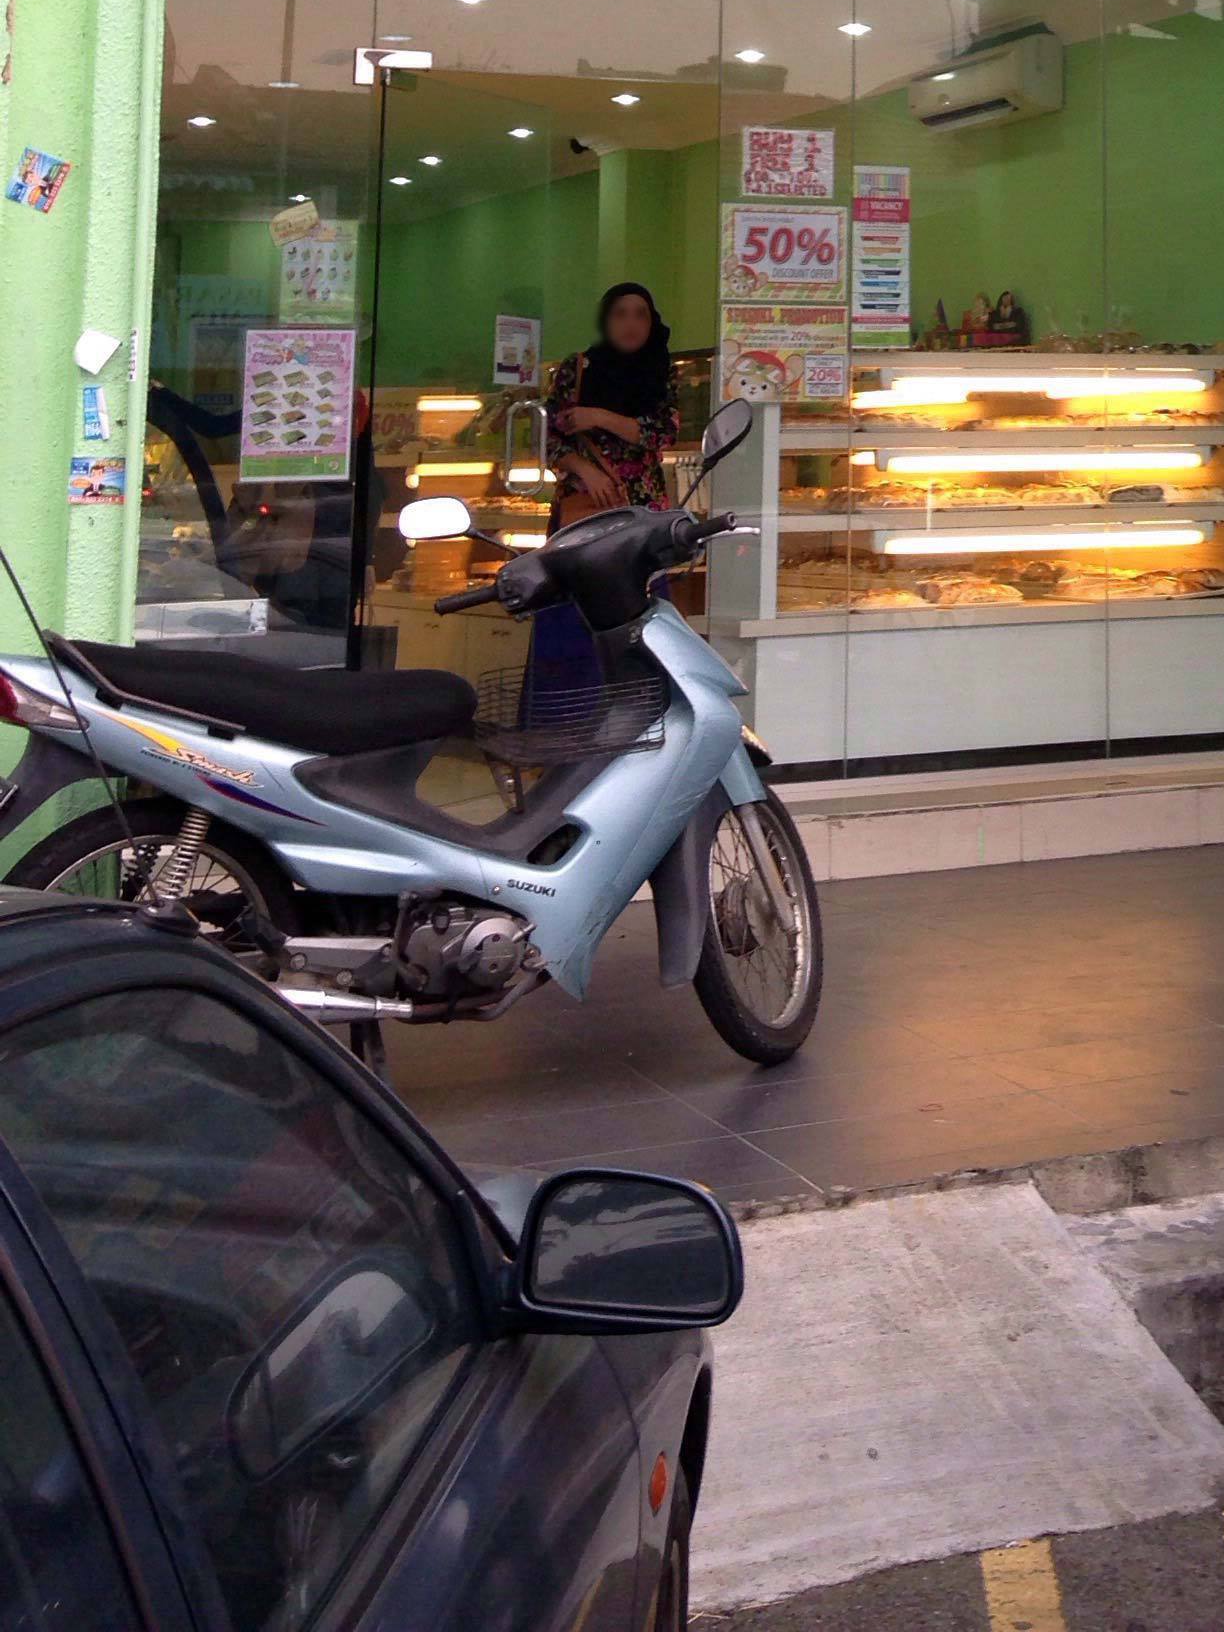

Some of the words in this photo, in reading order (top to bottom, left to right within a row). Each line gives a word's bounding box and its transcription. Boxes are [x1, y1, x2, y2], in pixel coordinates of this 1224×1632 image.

[741, 225, 836, 265] 50%
[772, 268, 806, 279] DISCOUNT
[810, 269, 834, 280] OFFER
[807, 368, 841, 382] 20%
[507, 879, 556, 897] SUZUKI
